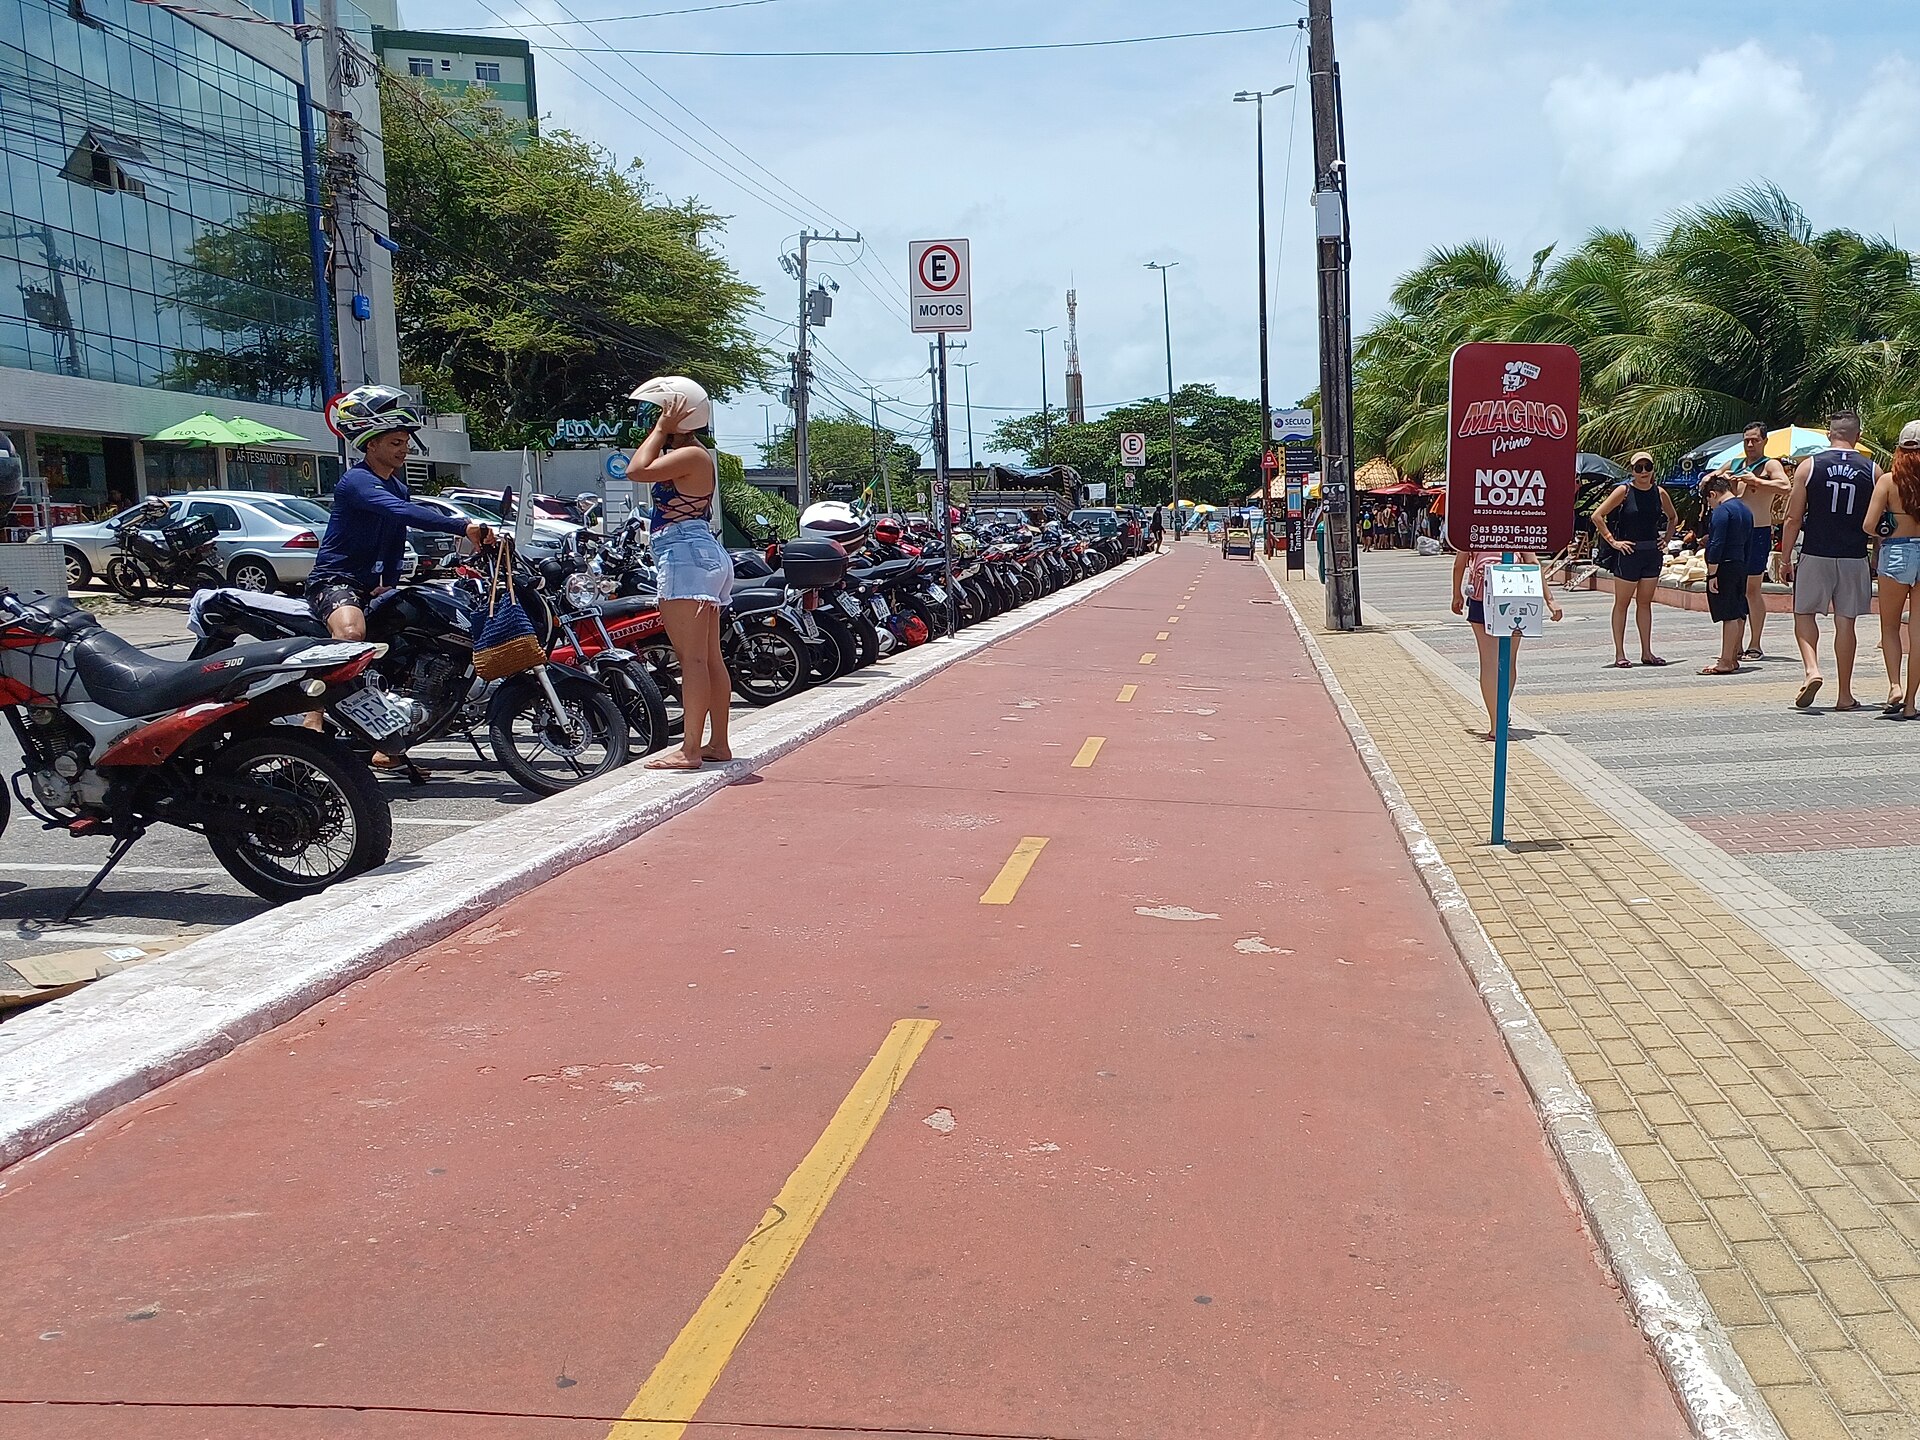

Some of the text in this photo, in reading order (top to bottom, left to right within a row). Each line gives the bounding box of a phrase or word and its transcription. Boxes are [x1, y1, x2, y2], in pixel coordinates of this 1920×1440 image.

[931, 255, 947, 281] E
[919, 304, 964, 317] MOTOS
[556, 418, 623, 438] FLOW
[1457, 399, 1568, 440] MAGNO
[1128, 438, 1137, 451] E
[1491, 435, 1533, 458] Prime
[1474, 468, 1548, 489] NOVA
[1473, 487, 1546, 508] LOJA!
[1825, 480, 1856, 515] 77
[1294, 520, 1302, 552] Tambaú
[1479, 524, 1548, 535] 83 99316-1023
[1479, 535, 1548, 545] grupo_magno
[365, 709, 406, 736] 7059
